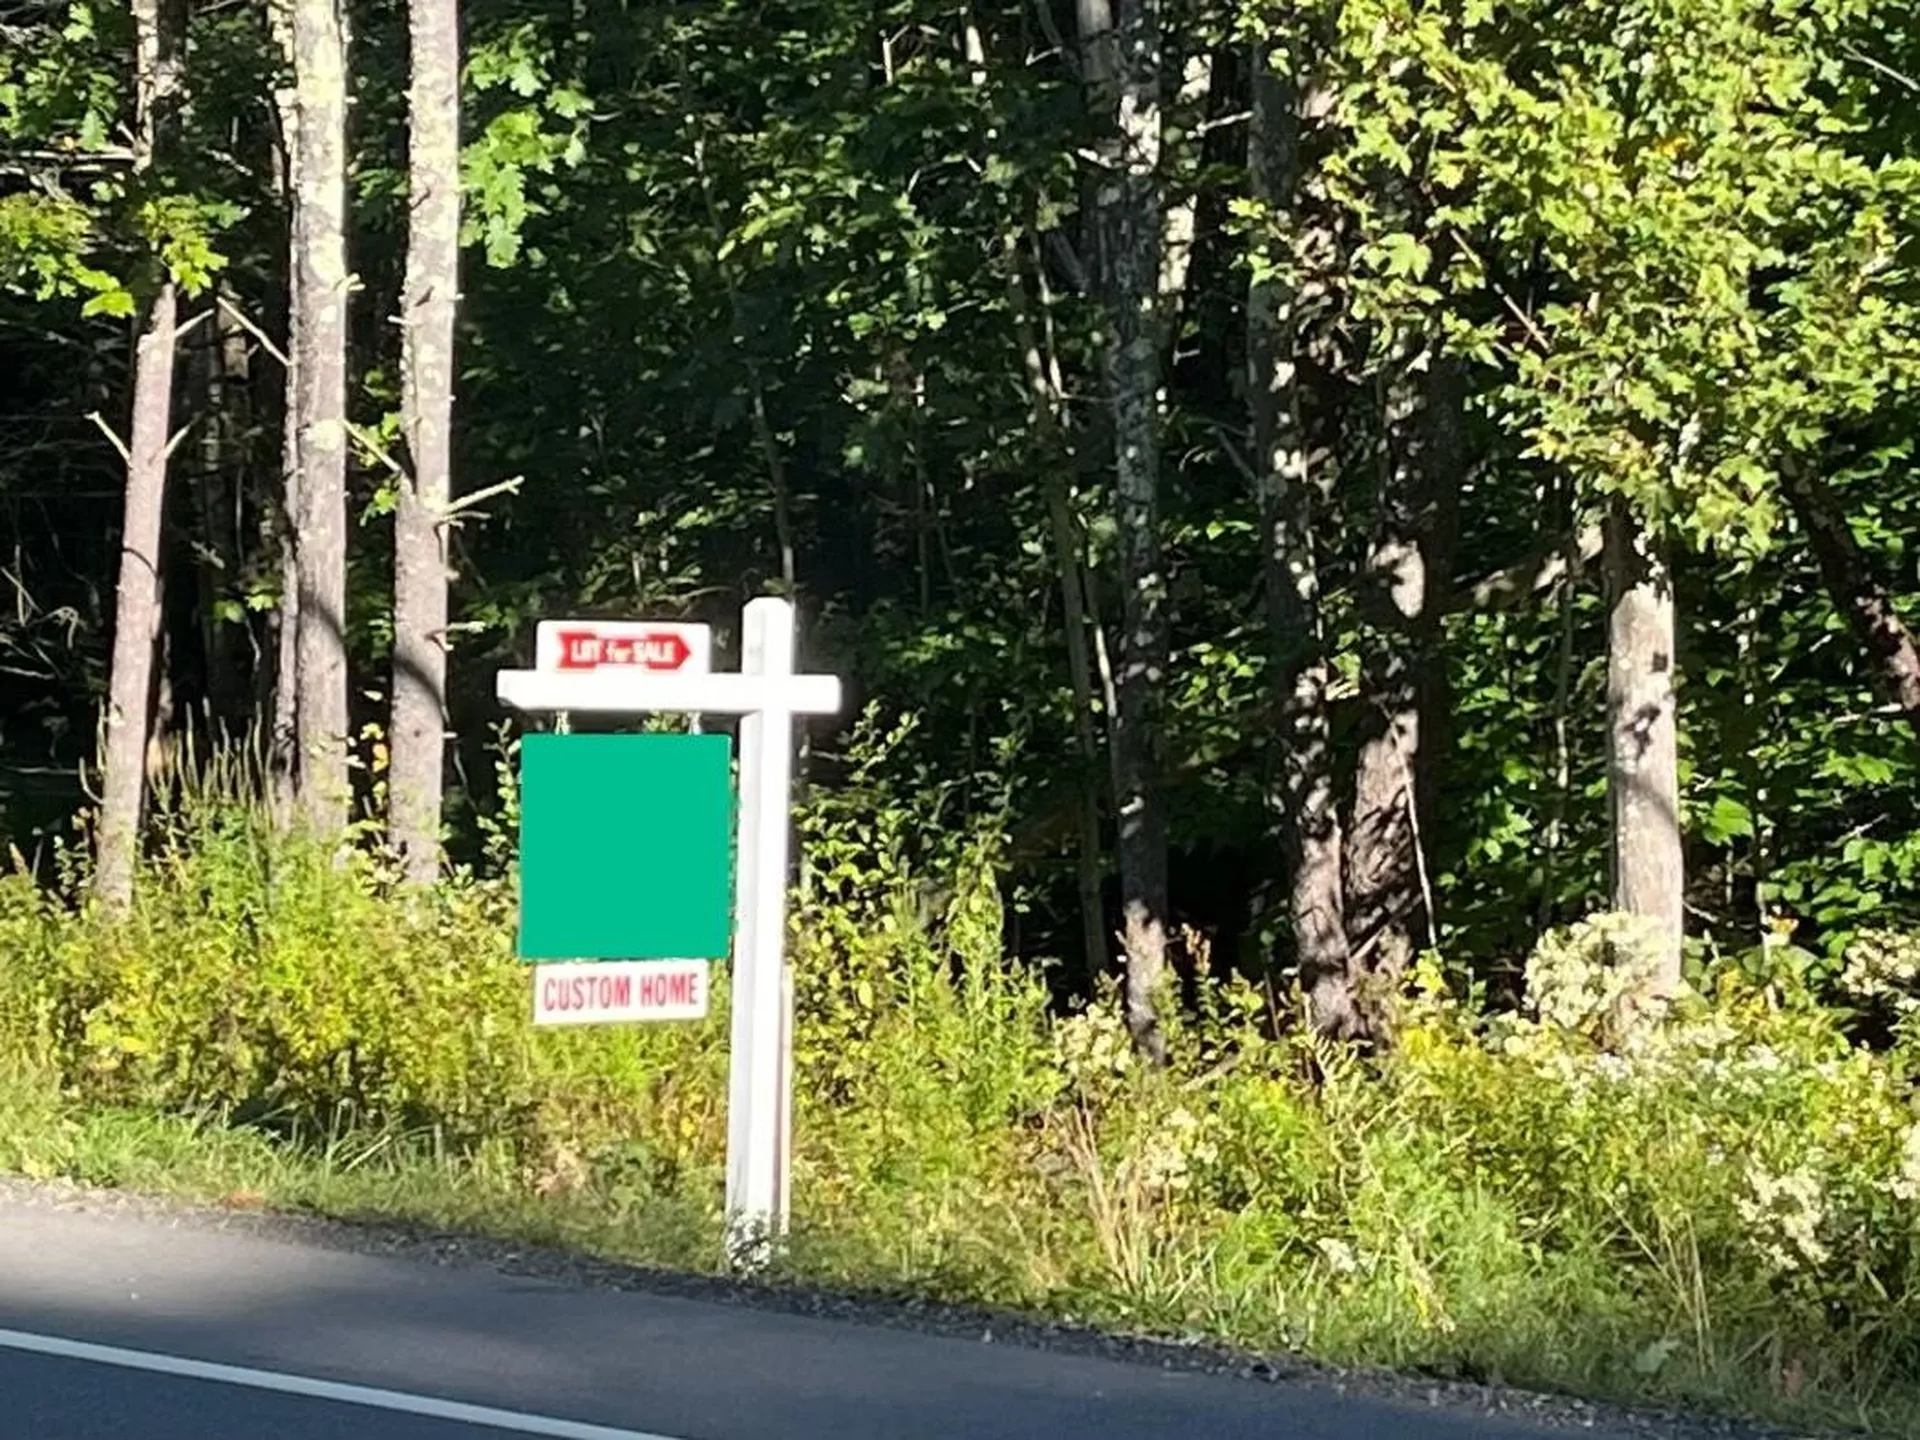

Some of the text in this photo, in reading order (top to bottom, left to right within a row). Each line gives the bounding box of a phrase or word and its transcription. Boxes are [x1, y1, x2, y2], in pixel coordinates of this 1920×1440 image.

[570, 639, 675, 662] LOT for SALE
[543, 972, 698, 1011] CUSTOM HOME
